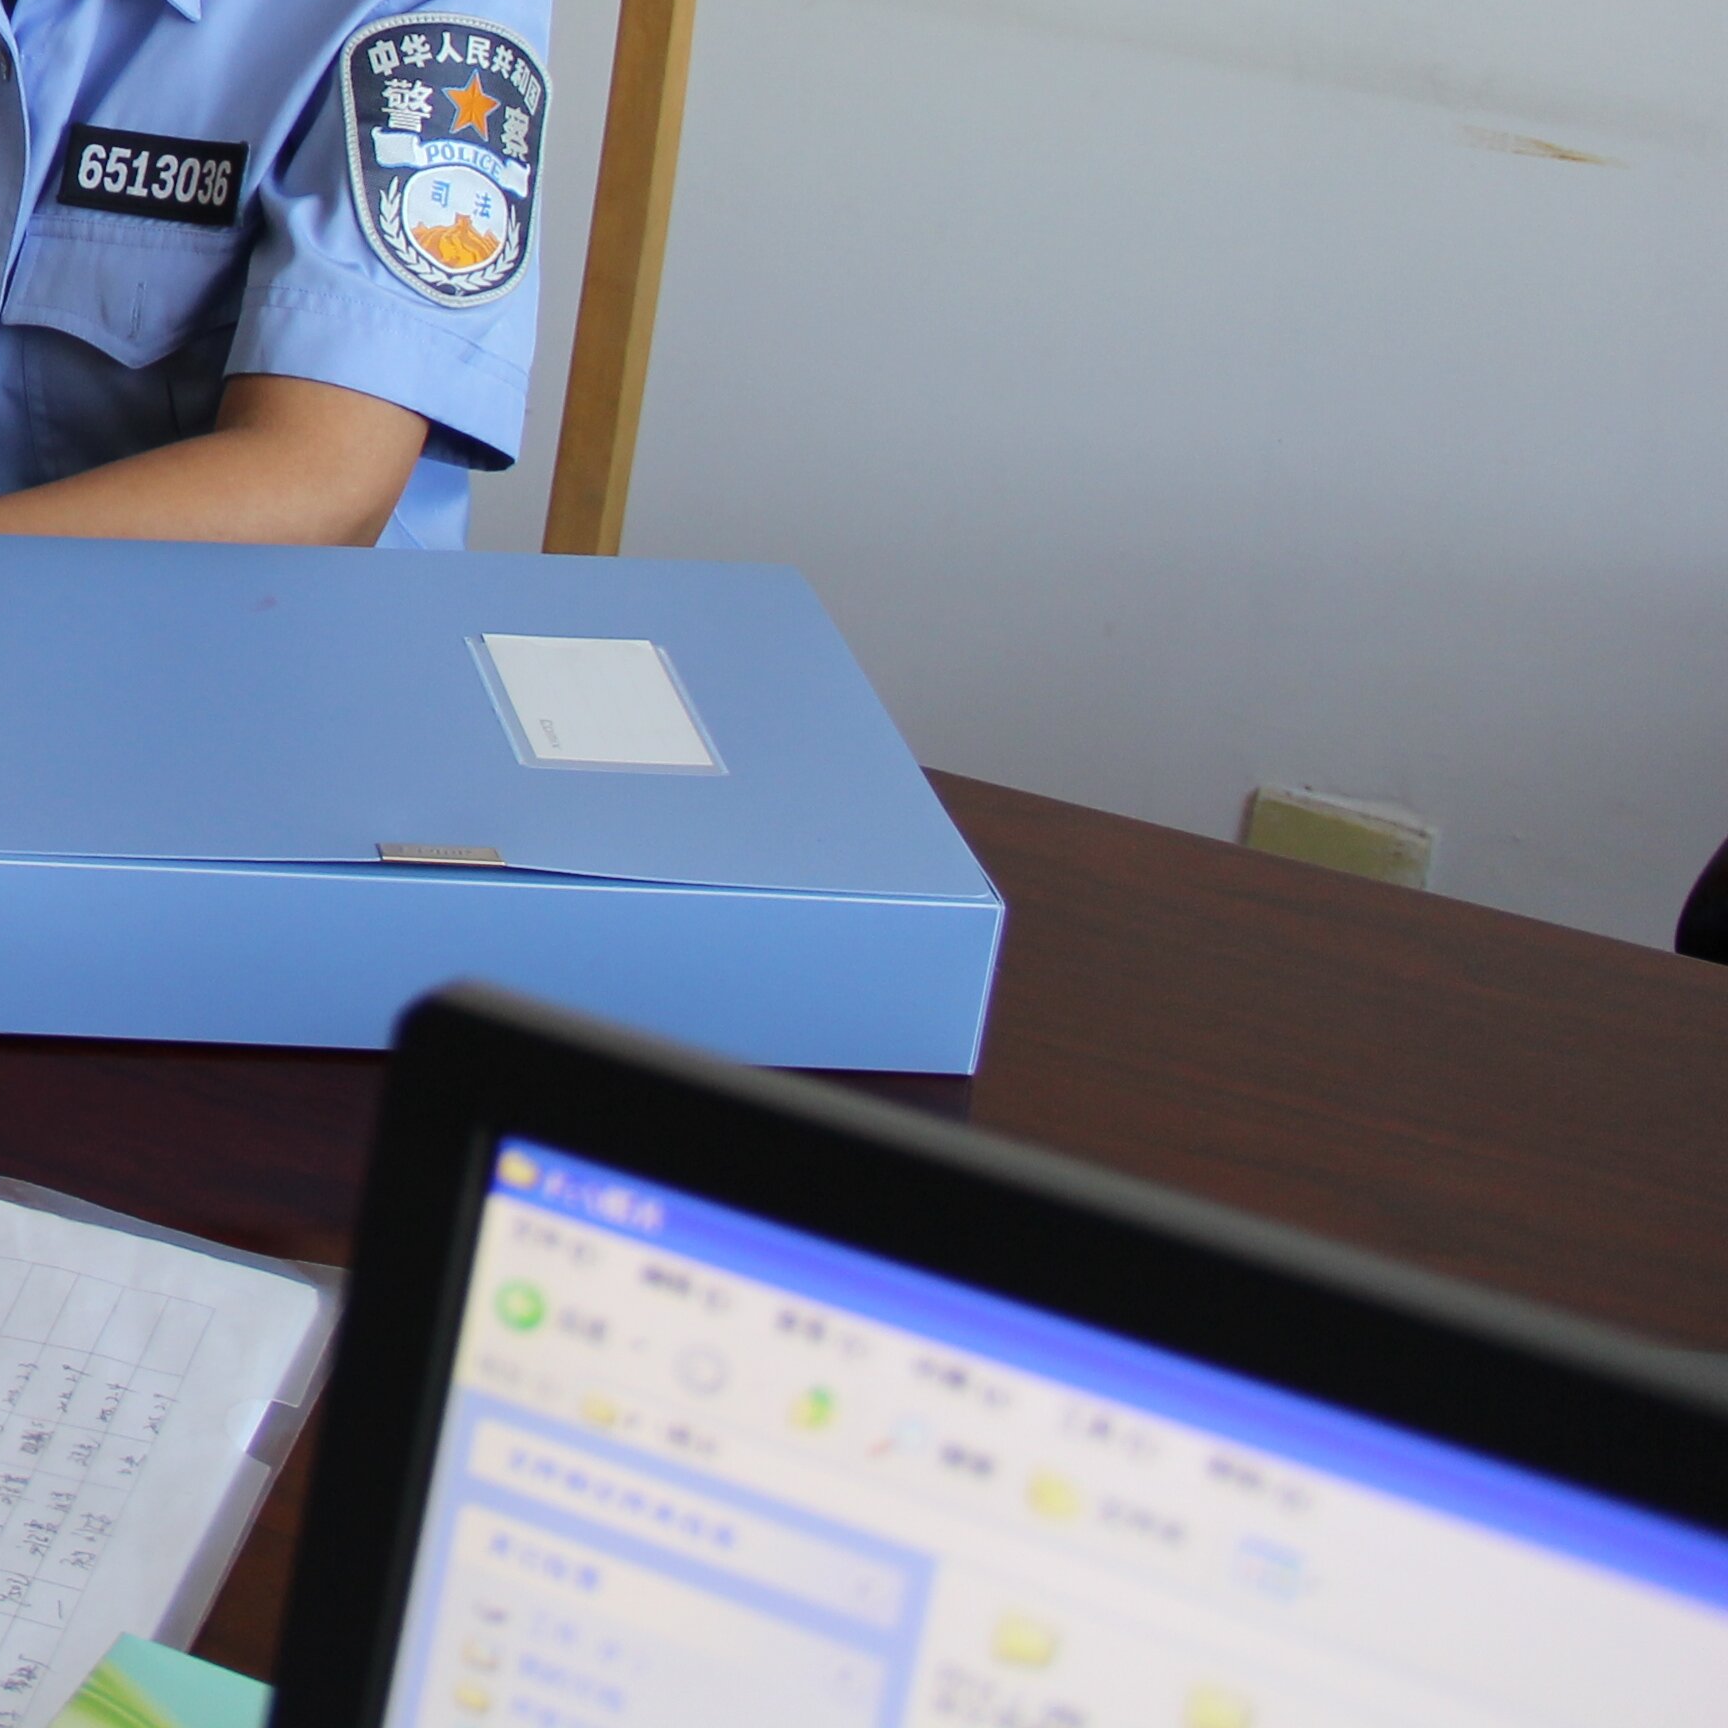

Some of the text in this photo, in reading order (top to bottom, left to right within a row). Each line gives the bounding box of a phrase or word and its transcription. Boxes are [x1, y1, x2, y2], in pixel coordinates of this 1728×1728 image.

[367, 31, 541, 116] 中华人民共和国
[77, 143, 232, 207] 6513036
[425, 141, 501, 182] POLICE
